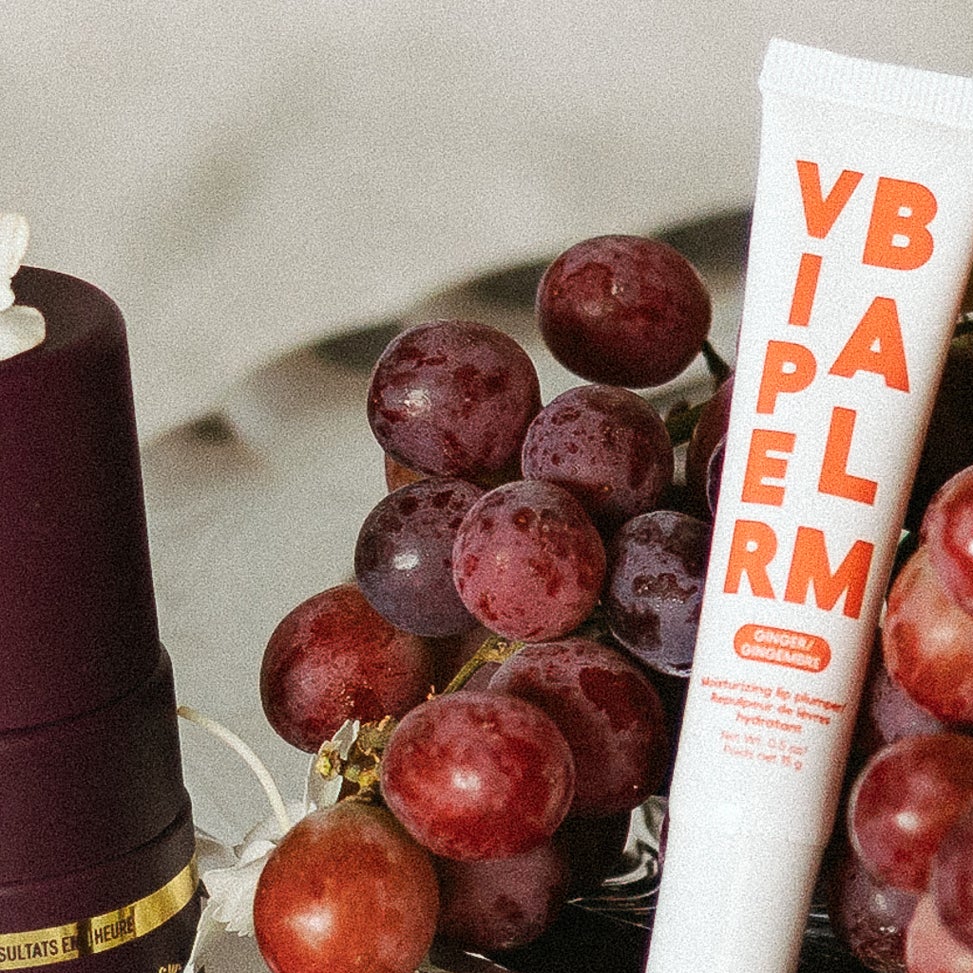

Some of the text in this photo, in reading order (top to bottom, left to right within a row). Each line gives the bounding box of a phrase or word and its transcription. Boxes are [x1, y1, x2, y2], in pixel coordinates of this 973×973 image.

[724, 160, 864, 599] VIPER
[785, 177, 938, 620] BALM
[94, 916, 135, 945] HEURE
